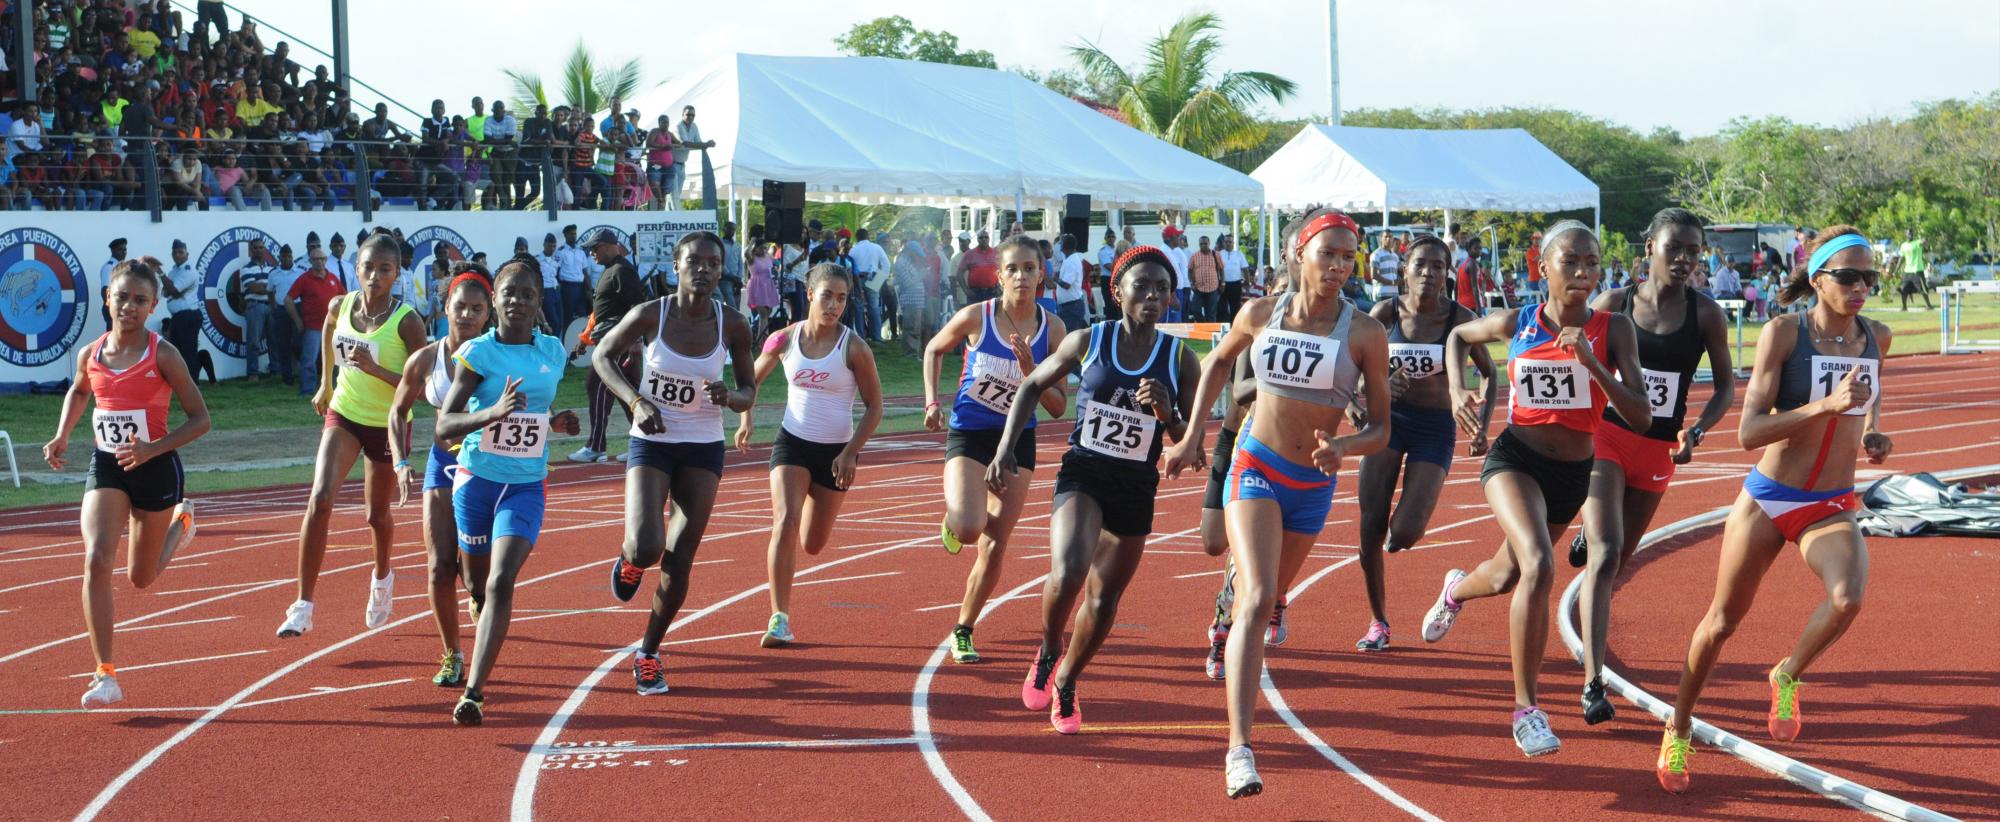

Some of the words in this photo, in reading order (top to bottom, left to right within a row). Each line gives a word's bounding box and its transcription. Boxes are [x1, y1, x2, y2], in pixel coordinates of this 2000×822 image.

[637, 222, 717, 231] PERFORMANCE
[0, 232, 19, 251] REA
[23, 230, 58, 248] PUERTO
[57, 243, 81, 276] PLATA
[198, 241, 221, 284] COMANDO
[221, 232, 233, 246] DE
[235, 229, 261, 241] APOYO
[338, 335, 356, 345] GRAND
[1268, 336, 1299, 347] GRAND
[1299, 340, 1322, 351] PRIX
[13, 348, 24, 363] DE
[26, 342, 64, 364] REPUBLICA
[1262, 344, 1325, 378] 107
[1521, 366, 1550, 374] GRAND
[1551, 366, 1573, 374] PRIX
[1821, 361, 1852, 372] GRAND
[1858, 364, 1871, 373] RIX
[651, 370, 675, 384] GRAND
[675, 378, 694, 386] PRIX
[984, 373, 1007, 387] GRAND
[1006, 383, 1019, 392] PRI
[1268, 372, 1288, 381] FARD
[1289, 376, 1310, 384] 2016
[1520, 373, 1576, 398] 131
[1648, 375, 1667, 384] PRIX
[1818, 371, 1873, 399] 13
[648, 377, 696, 405] 180
[652, 396, 668, 404] FARD
[976, 380, 1016, 409] 179
[96, 414, 115, 422] GRAND
[520, 417, 538, 425] PRIX
[1093, 407, 1121, 421] GRAND
[1122, 413, 1142, 426] PRIX
[97, 421, 138, 443] 132
[489, 422, 540, 447] 135
[1088, 416, 1143, 450] 125
[1092, 440, 1110, 450] FARD
[1111, 445, 1129, 454] 2016
